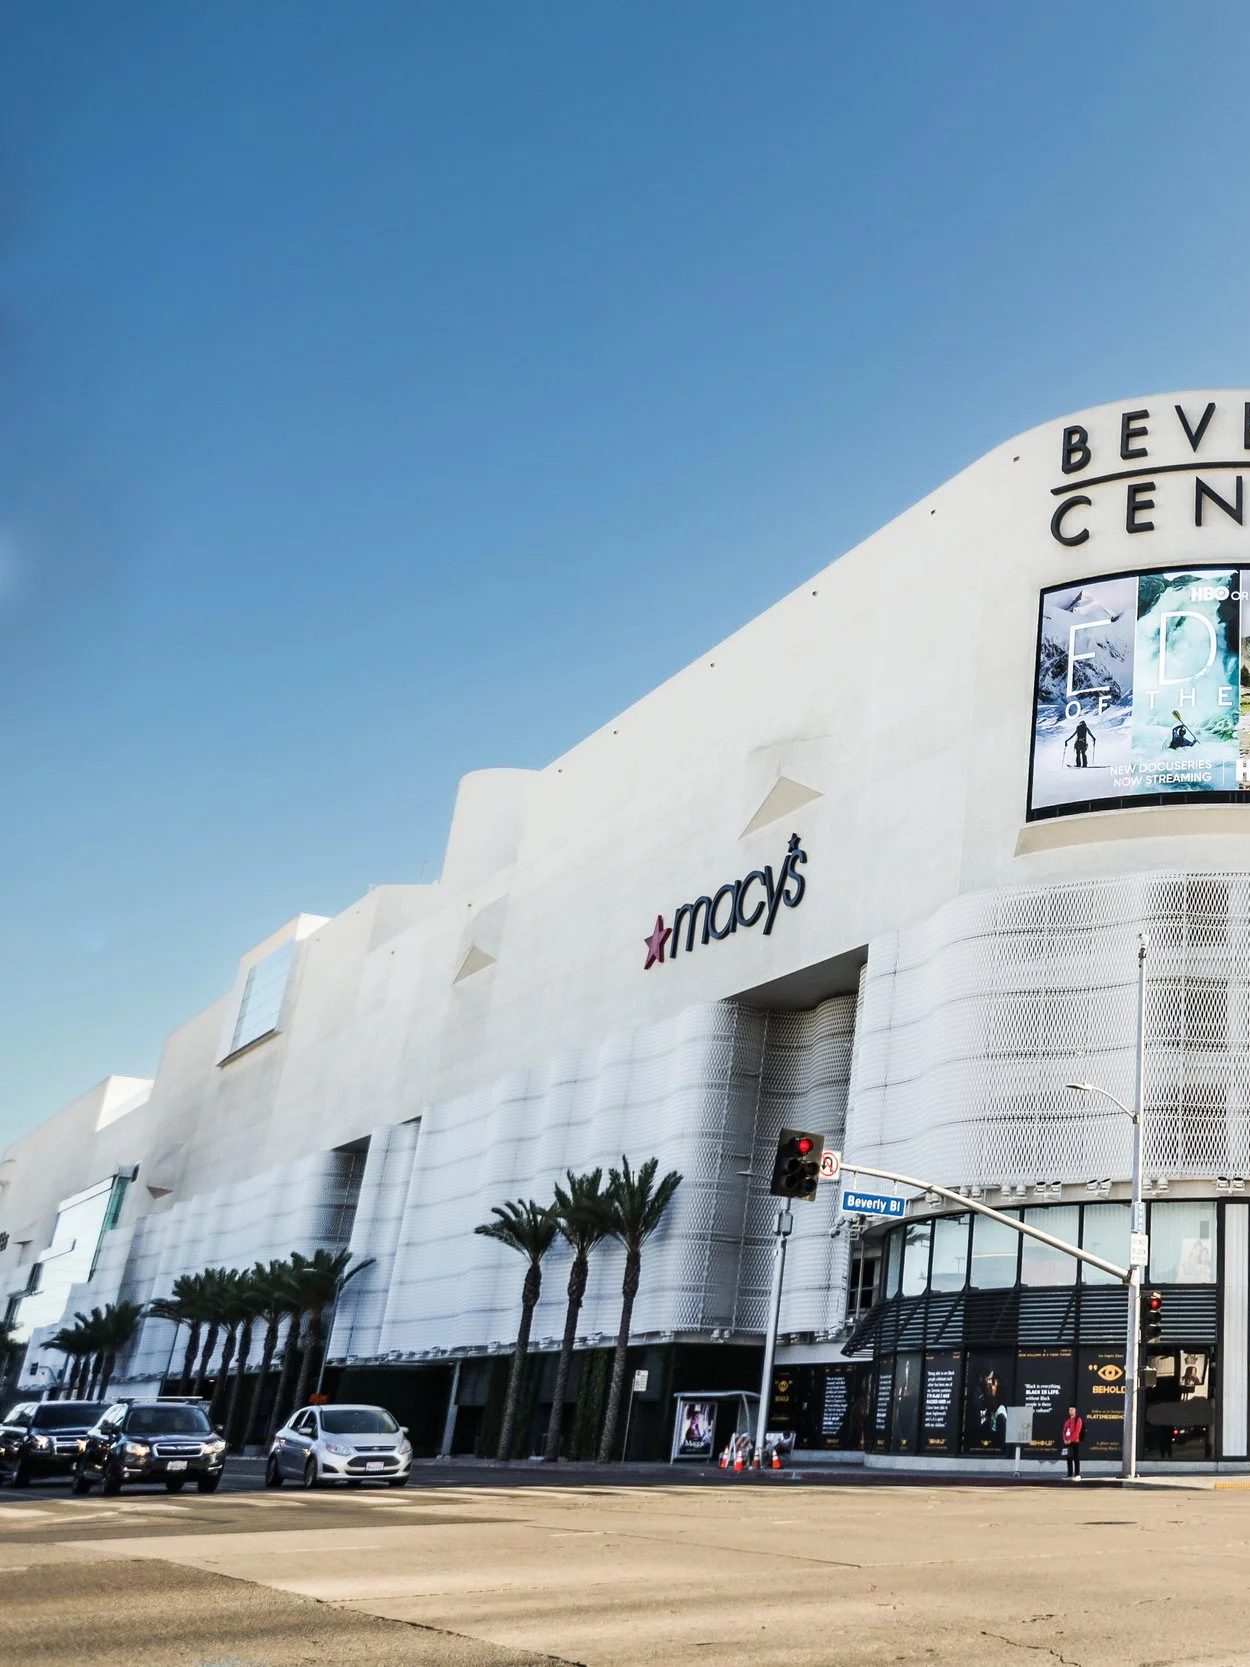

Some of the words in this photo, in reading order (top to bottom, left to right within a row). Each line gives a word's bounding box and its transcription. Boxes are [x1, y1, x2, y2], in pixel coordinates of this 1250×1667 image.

[1190, 585, 1229, 602] HBO
[1064, 696, 1111, 720] OF
[1144, 686, 1233, 710] THE
[1109, 764, 1136, 776] NEW
[1139, 759, 1213, 773] DOCUSERIES
[1113, 774, 1143, 788] NOW
[1145, 771, 1213, 785] STREAMING
[847, 1194, 888, 1213] Beverly
[889, 1199, 901, 1213] Bl
